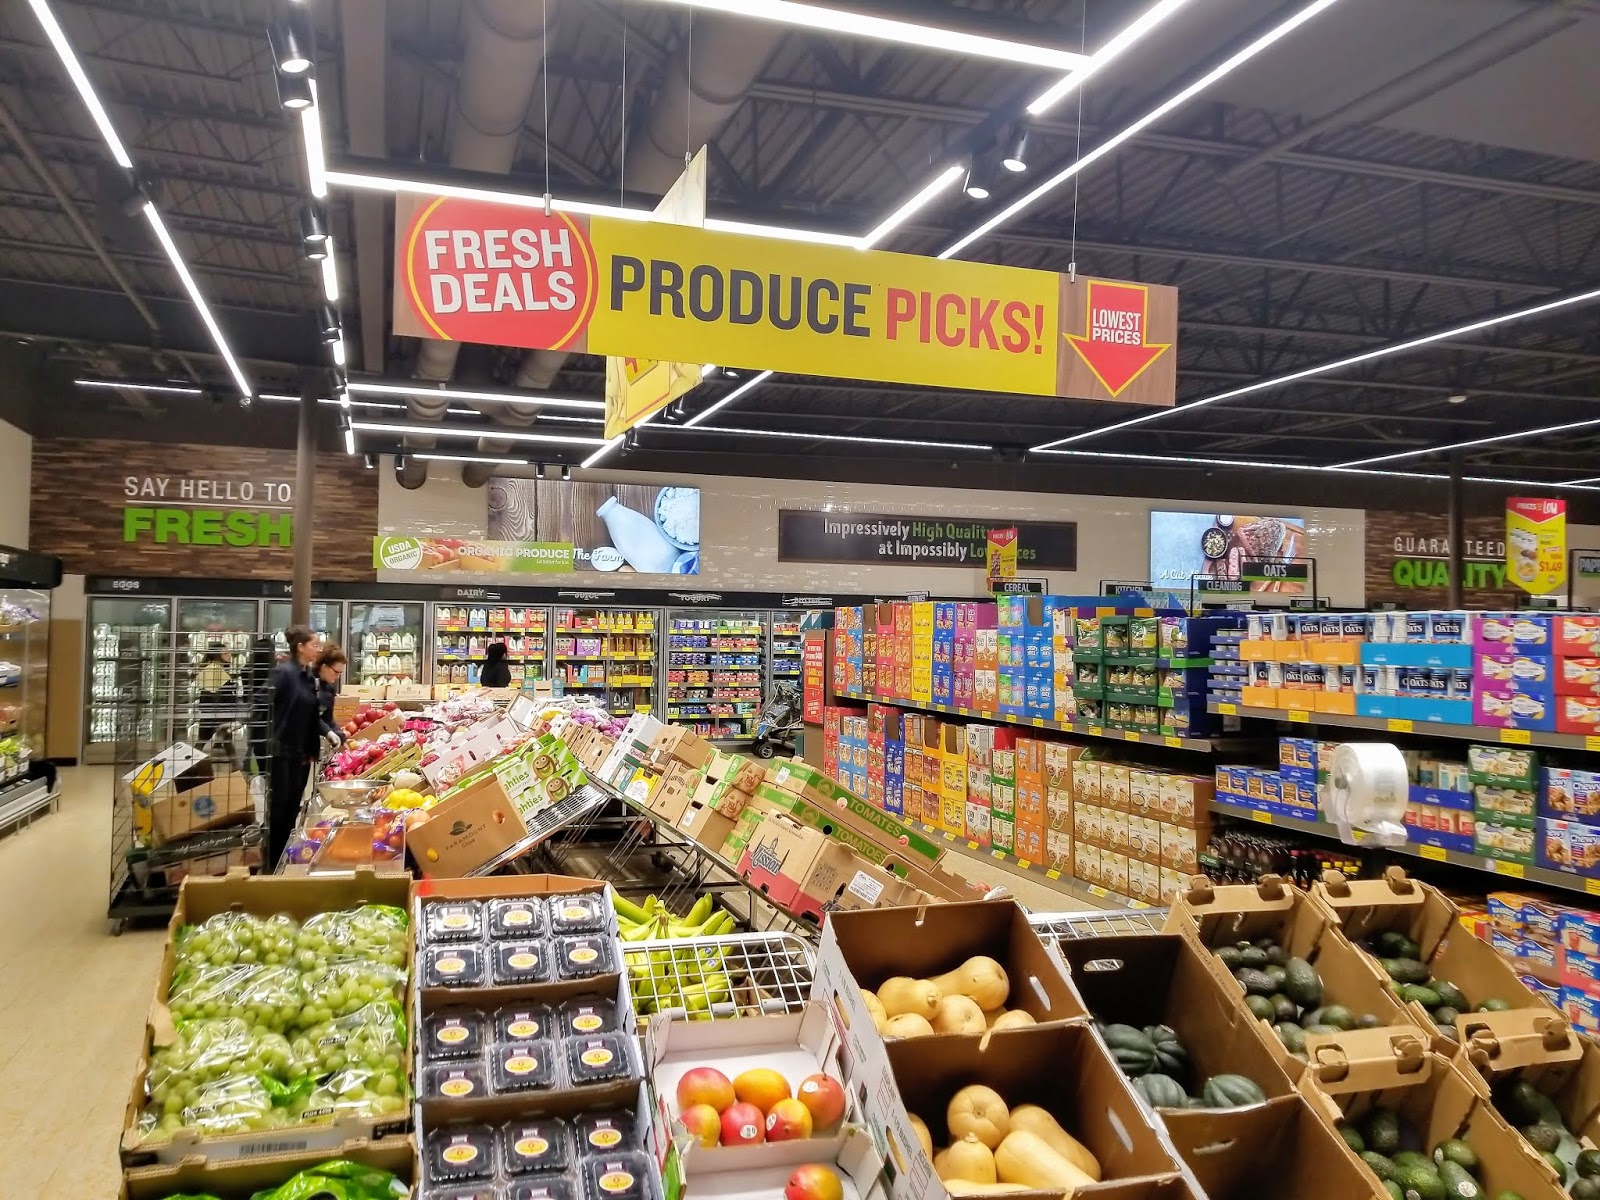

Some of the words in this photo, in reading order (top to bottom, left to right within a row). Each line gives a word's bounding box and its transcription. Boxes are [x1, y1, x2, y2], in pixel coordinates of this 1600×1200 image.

[424, 229, 572, 269] FRESH
[430, 271, 576, 314] DEALS
[610, 255, 872, 338] PRODUCE
[887, 287, 1044, 355] PICKS!
[1093, 308, 1141, 332] LOWEST
[1092, 327, 1141, 345] PRICES
[124, 477, 169, 497] SAY
[180, 480, 254, 501] HELLO
[264, 483, 292, 502] TO
[1543, 501, 1558, 514] LOW
[123, 508, 293, 547] FRESH
[824, 518, 910, 541] Impressively
[912, 522, 944, 541] High
[946, 524, 995, 541] Qualit
[387, 541, 412, 554] USDA
[457, 546, 513, 557] ORGANIC
[515, 548, 570, 559] PRODUCE
[878, 541, 893, 555] at
[896, 540, 967, 561] Impossibly
[970, 543, 988, 558] Lo
[1394, 537, 1505, 556] GUARATEED
[389, 550, 418, 564] ORGANIC
[573, 548, 591, 560] The
[1263, 564, 1287, 577] OATS
[1392, 560, 1506, 589] QUAITY
[112, 580, 140, 590] EGGS
[1004, 583, 1030, 592] CEREAL
[1206, 581, 1243, 591] CLEANING
[457, 589, 484, 597] DAIRY
[1301, 624, 1319, 632] OATS
[1322, 625, 1340, 633] OATS
[1344, 625, 1364, 633] OATS
[1304, 673, 1321, 681] OATS
[1410, 679, 1429, 687] OATS
[1431, 680, 1445, 688] ATS
[849, 798, 902, 838] TOMATES
[836, 827, 886, 863] TOMATOES
[1570, 834, 1598, 846] Chewy
